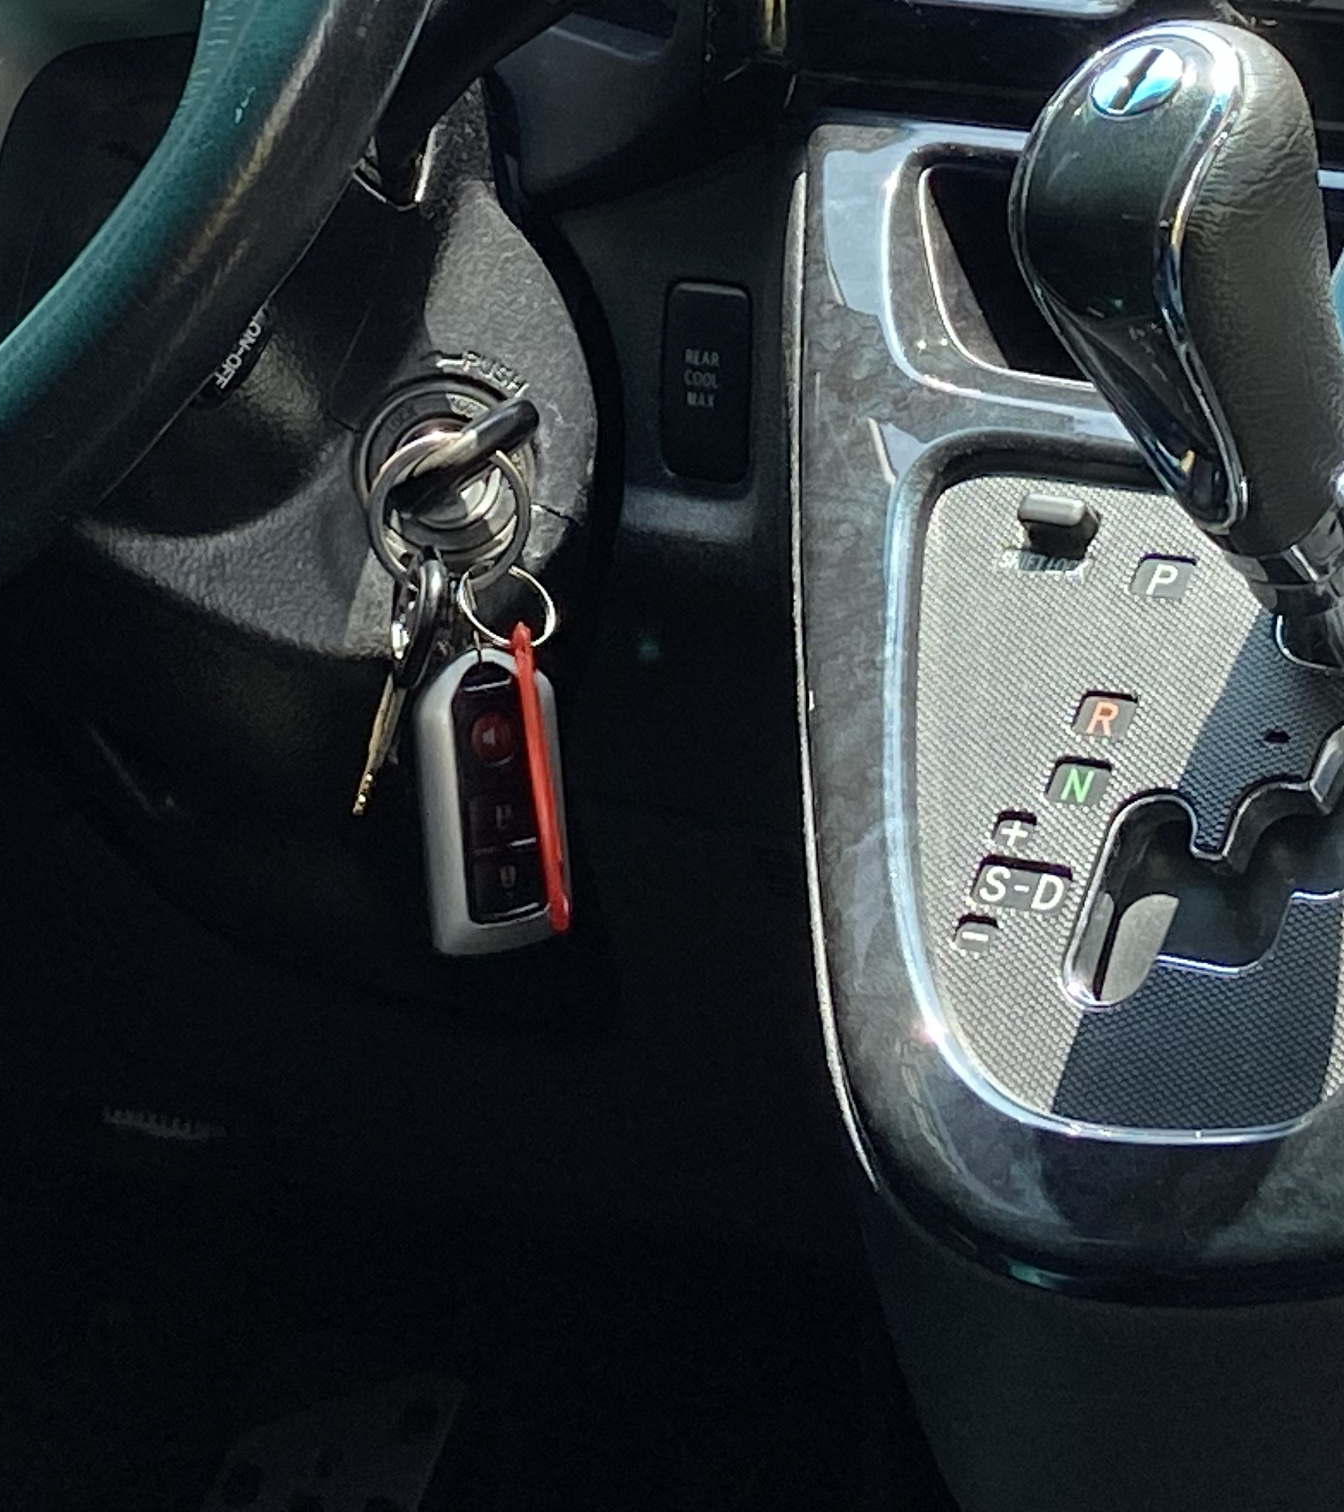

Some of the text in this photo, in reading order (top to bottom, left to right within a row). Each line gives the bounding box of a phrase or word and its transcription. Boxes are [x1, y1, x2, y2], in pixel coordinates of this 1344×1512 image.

[1145, 563, 1179, 596] P
[1085, 700, 1119, 736] R
[1060, 768, 1098, 803] N
